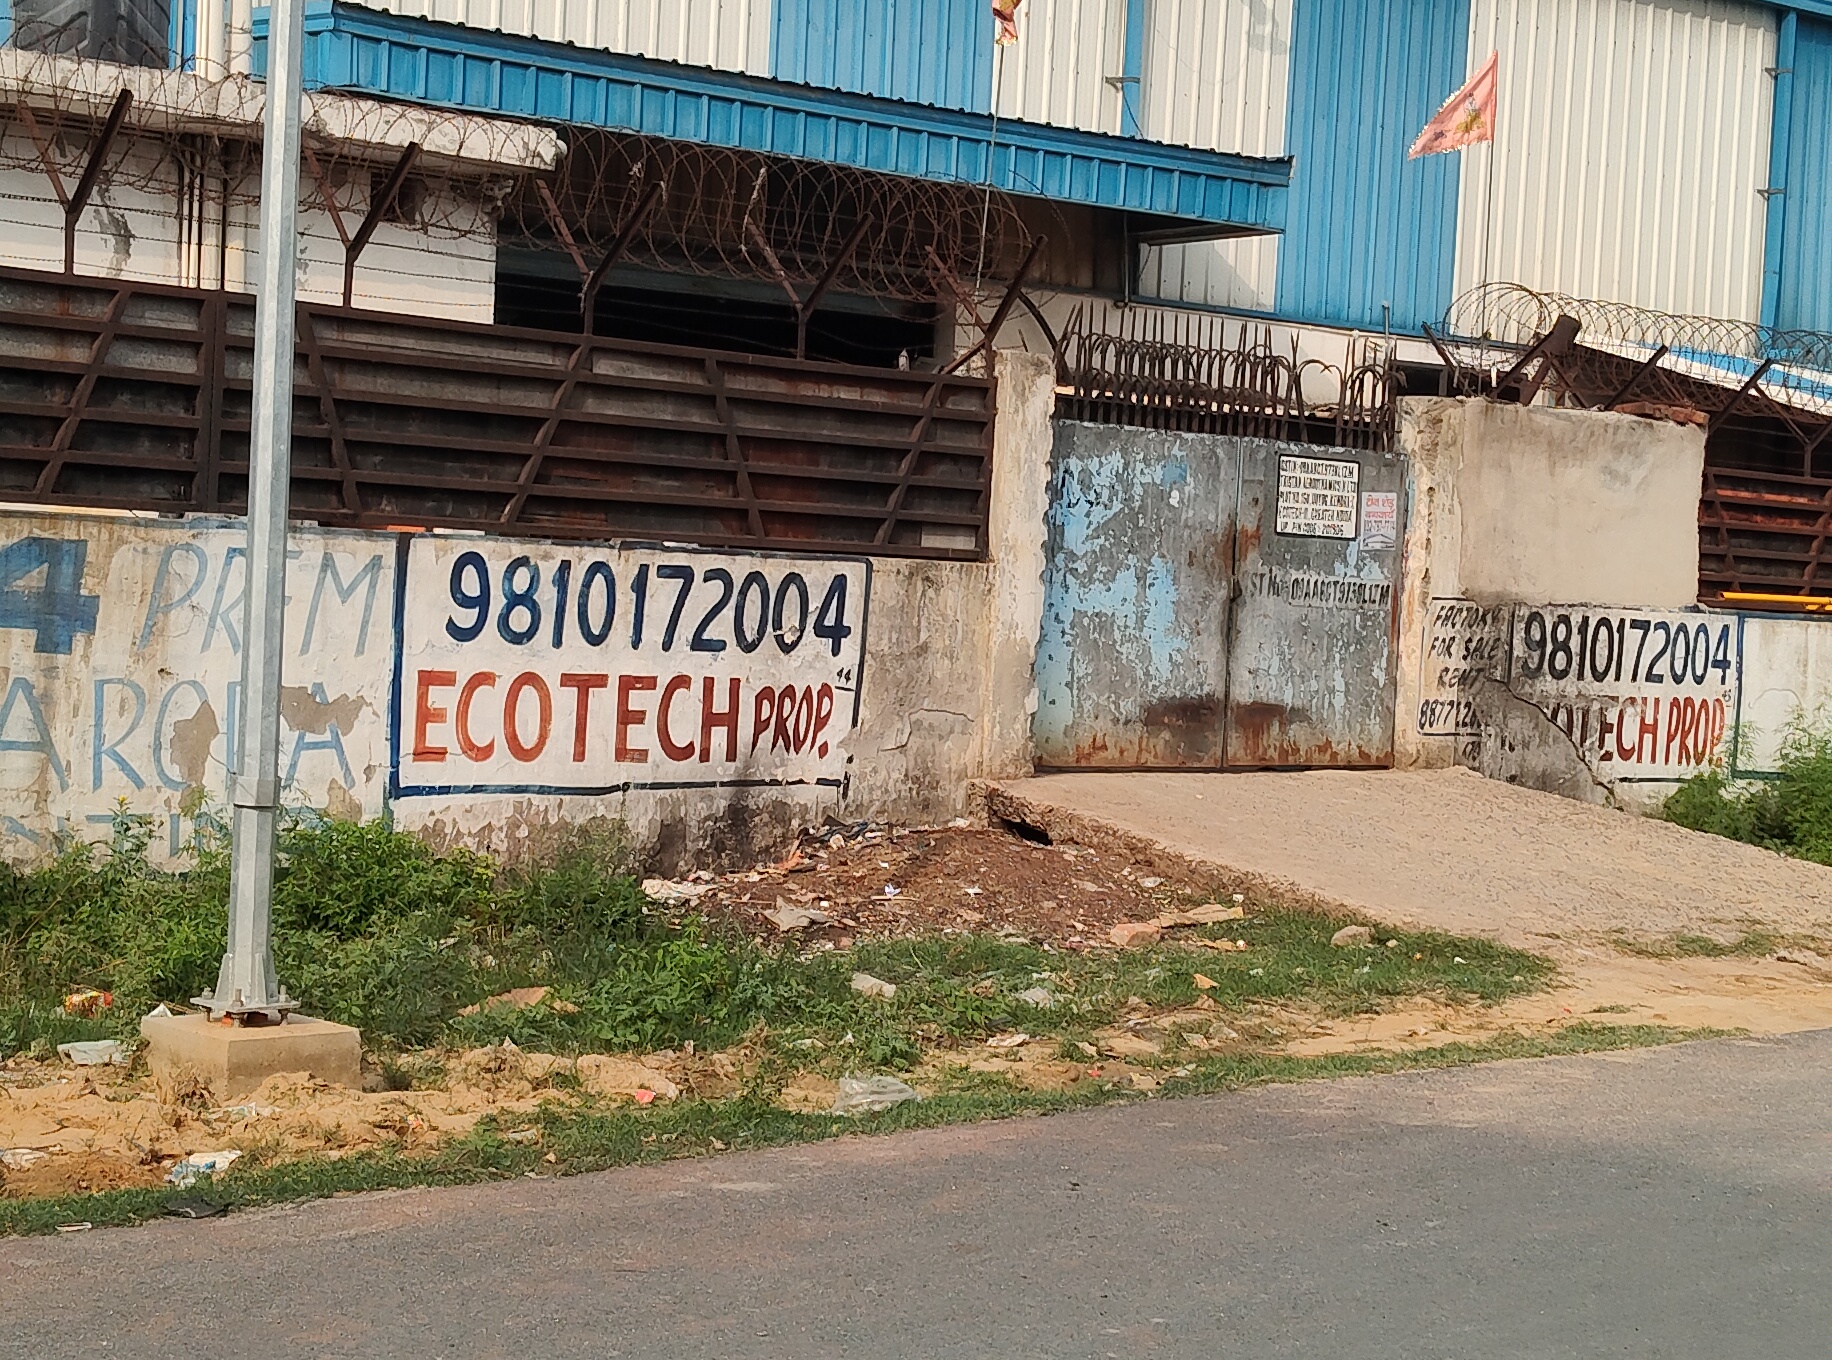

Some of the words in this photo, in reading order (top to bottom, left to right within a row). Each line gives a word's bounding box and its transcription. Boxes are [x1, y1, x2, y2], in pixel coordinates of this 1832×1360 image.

[137, 542, 384, 658] PRM
[445, 551, 852, 658] 9810172004
[1427, 635, 1456, 659] FOR
[1462, 637, 1502, 661] SALE
[1521, 611, 1731, 685] 9810172004
[0, 677, 356, 794] AROA
[412, 669, 742, 763] ECOTECH
[750, 682, 834, 759] PROP.
